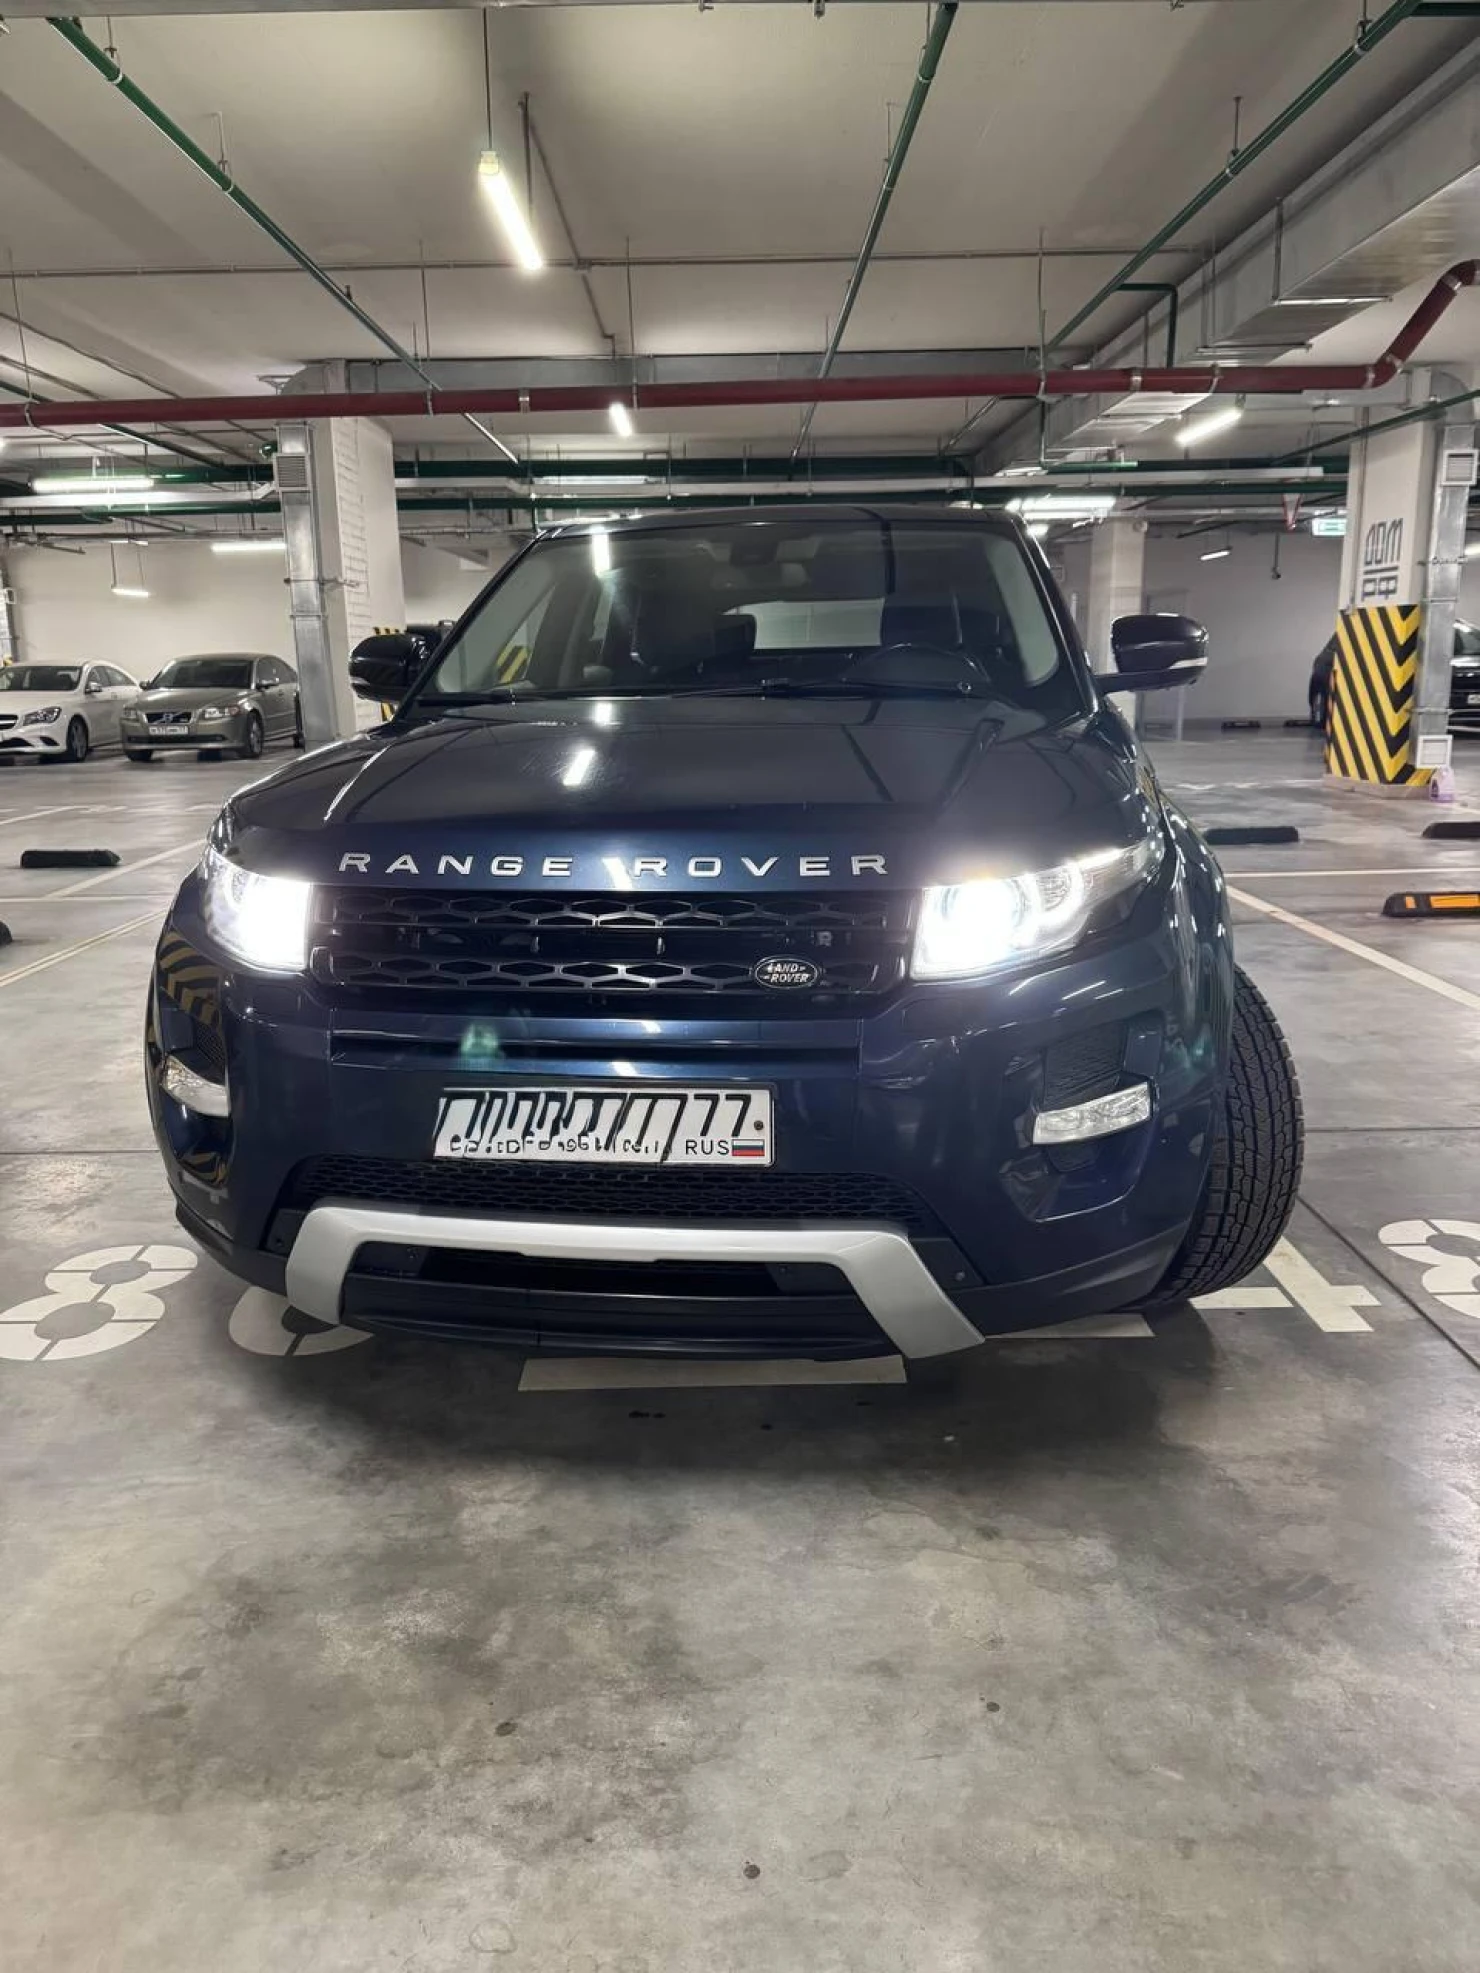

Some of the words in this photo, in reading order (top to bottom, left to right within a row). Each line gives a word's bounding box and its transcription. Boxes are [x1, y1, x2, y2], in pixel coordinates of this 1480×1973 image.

[339, 852, 573, 878] RANGE
[633, 854, 888, 879] ROVER
[766, 962, 798, 974] LAND
[770, 974, 809, 983] ROVER
[685, 1138, 730, 1156] RUS
